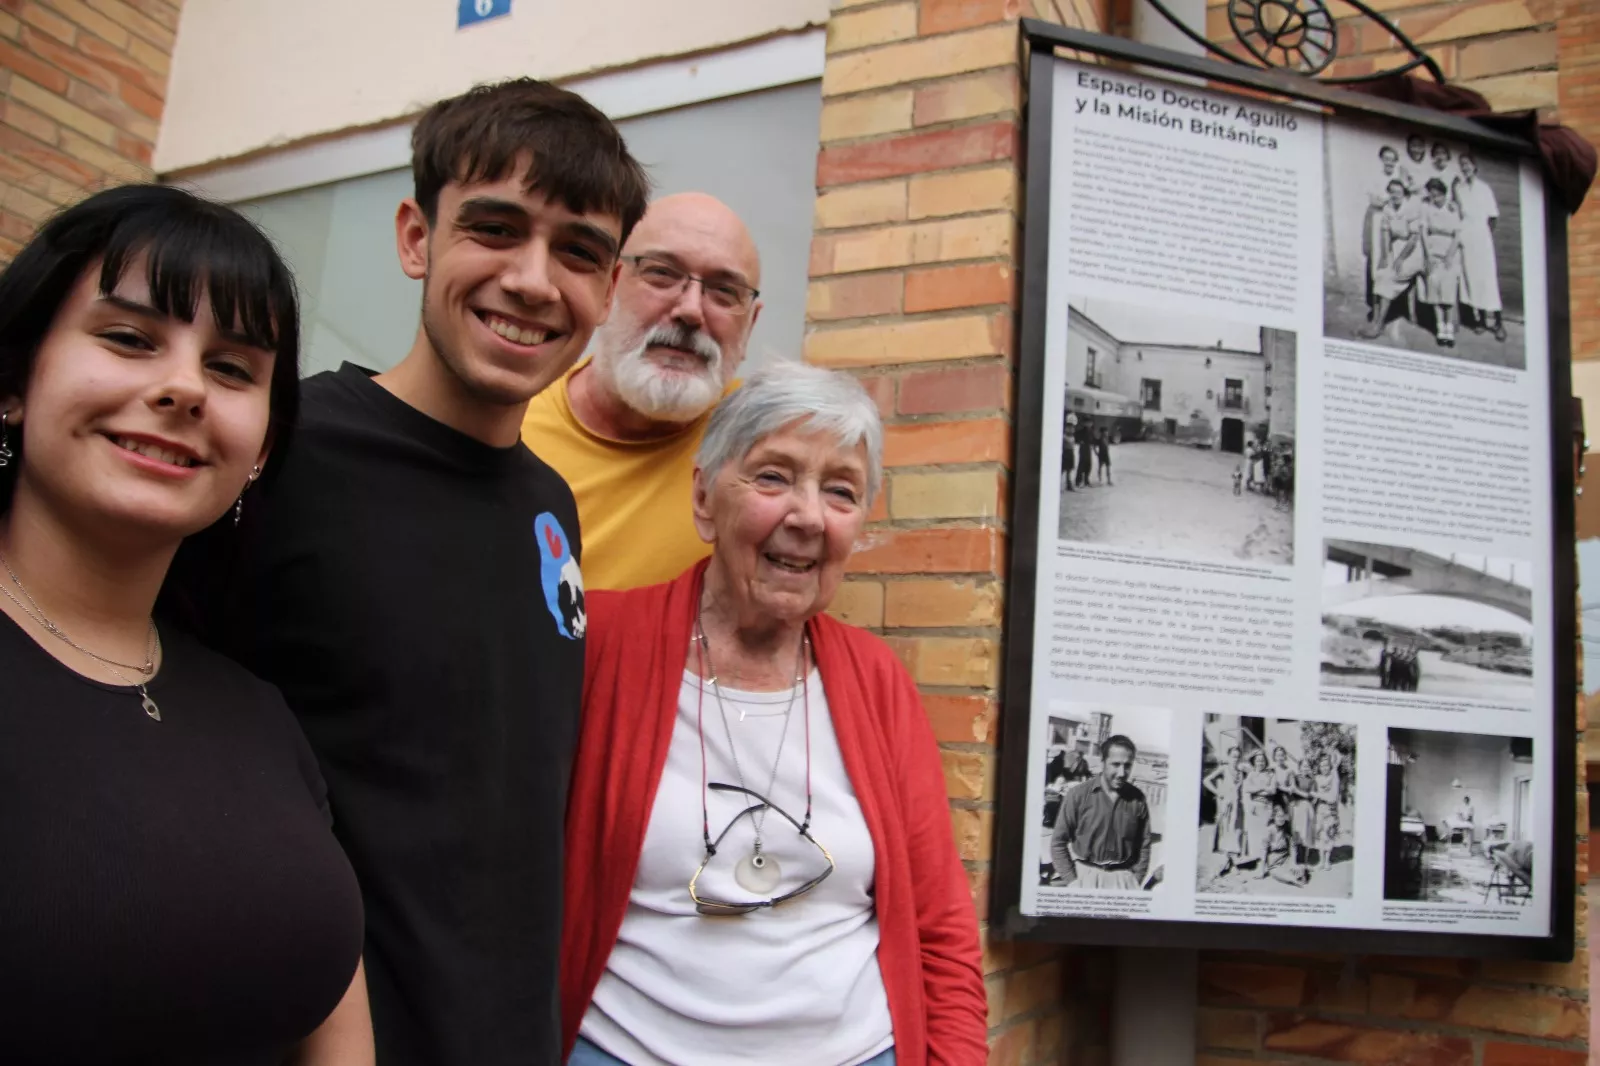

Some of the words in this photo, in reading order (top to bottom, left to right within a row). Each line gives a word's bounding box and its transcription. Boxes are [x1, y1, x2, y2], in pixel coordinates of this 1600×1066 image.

[1075, 97, 1088, 114] y
[1093, 97, 1111, 116] la
[1118, 103, 1184, 131] Misión
[1190, 118, 1279, 150] Británica
[1077, 71, 1156, 101] Espacio
[1162, 88, 1229, 117] Doctor
[1235, 106, 1298, 132] Aguiló
